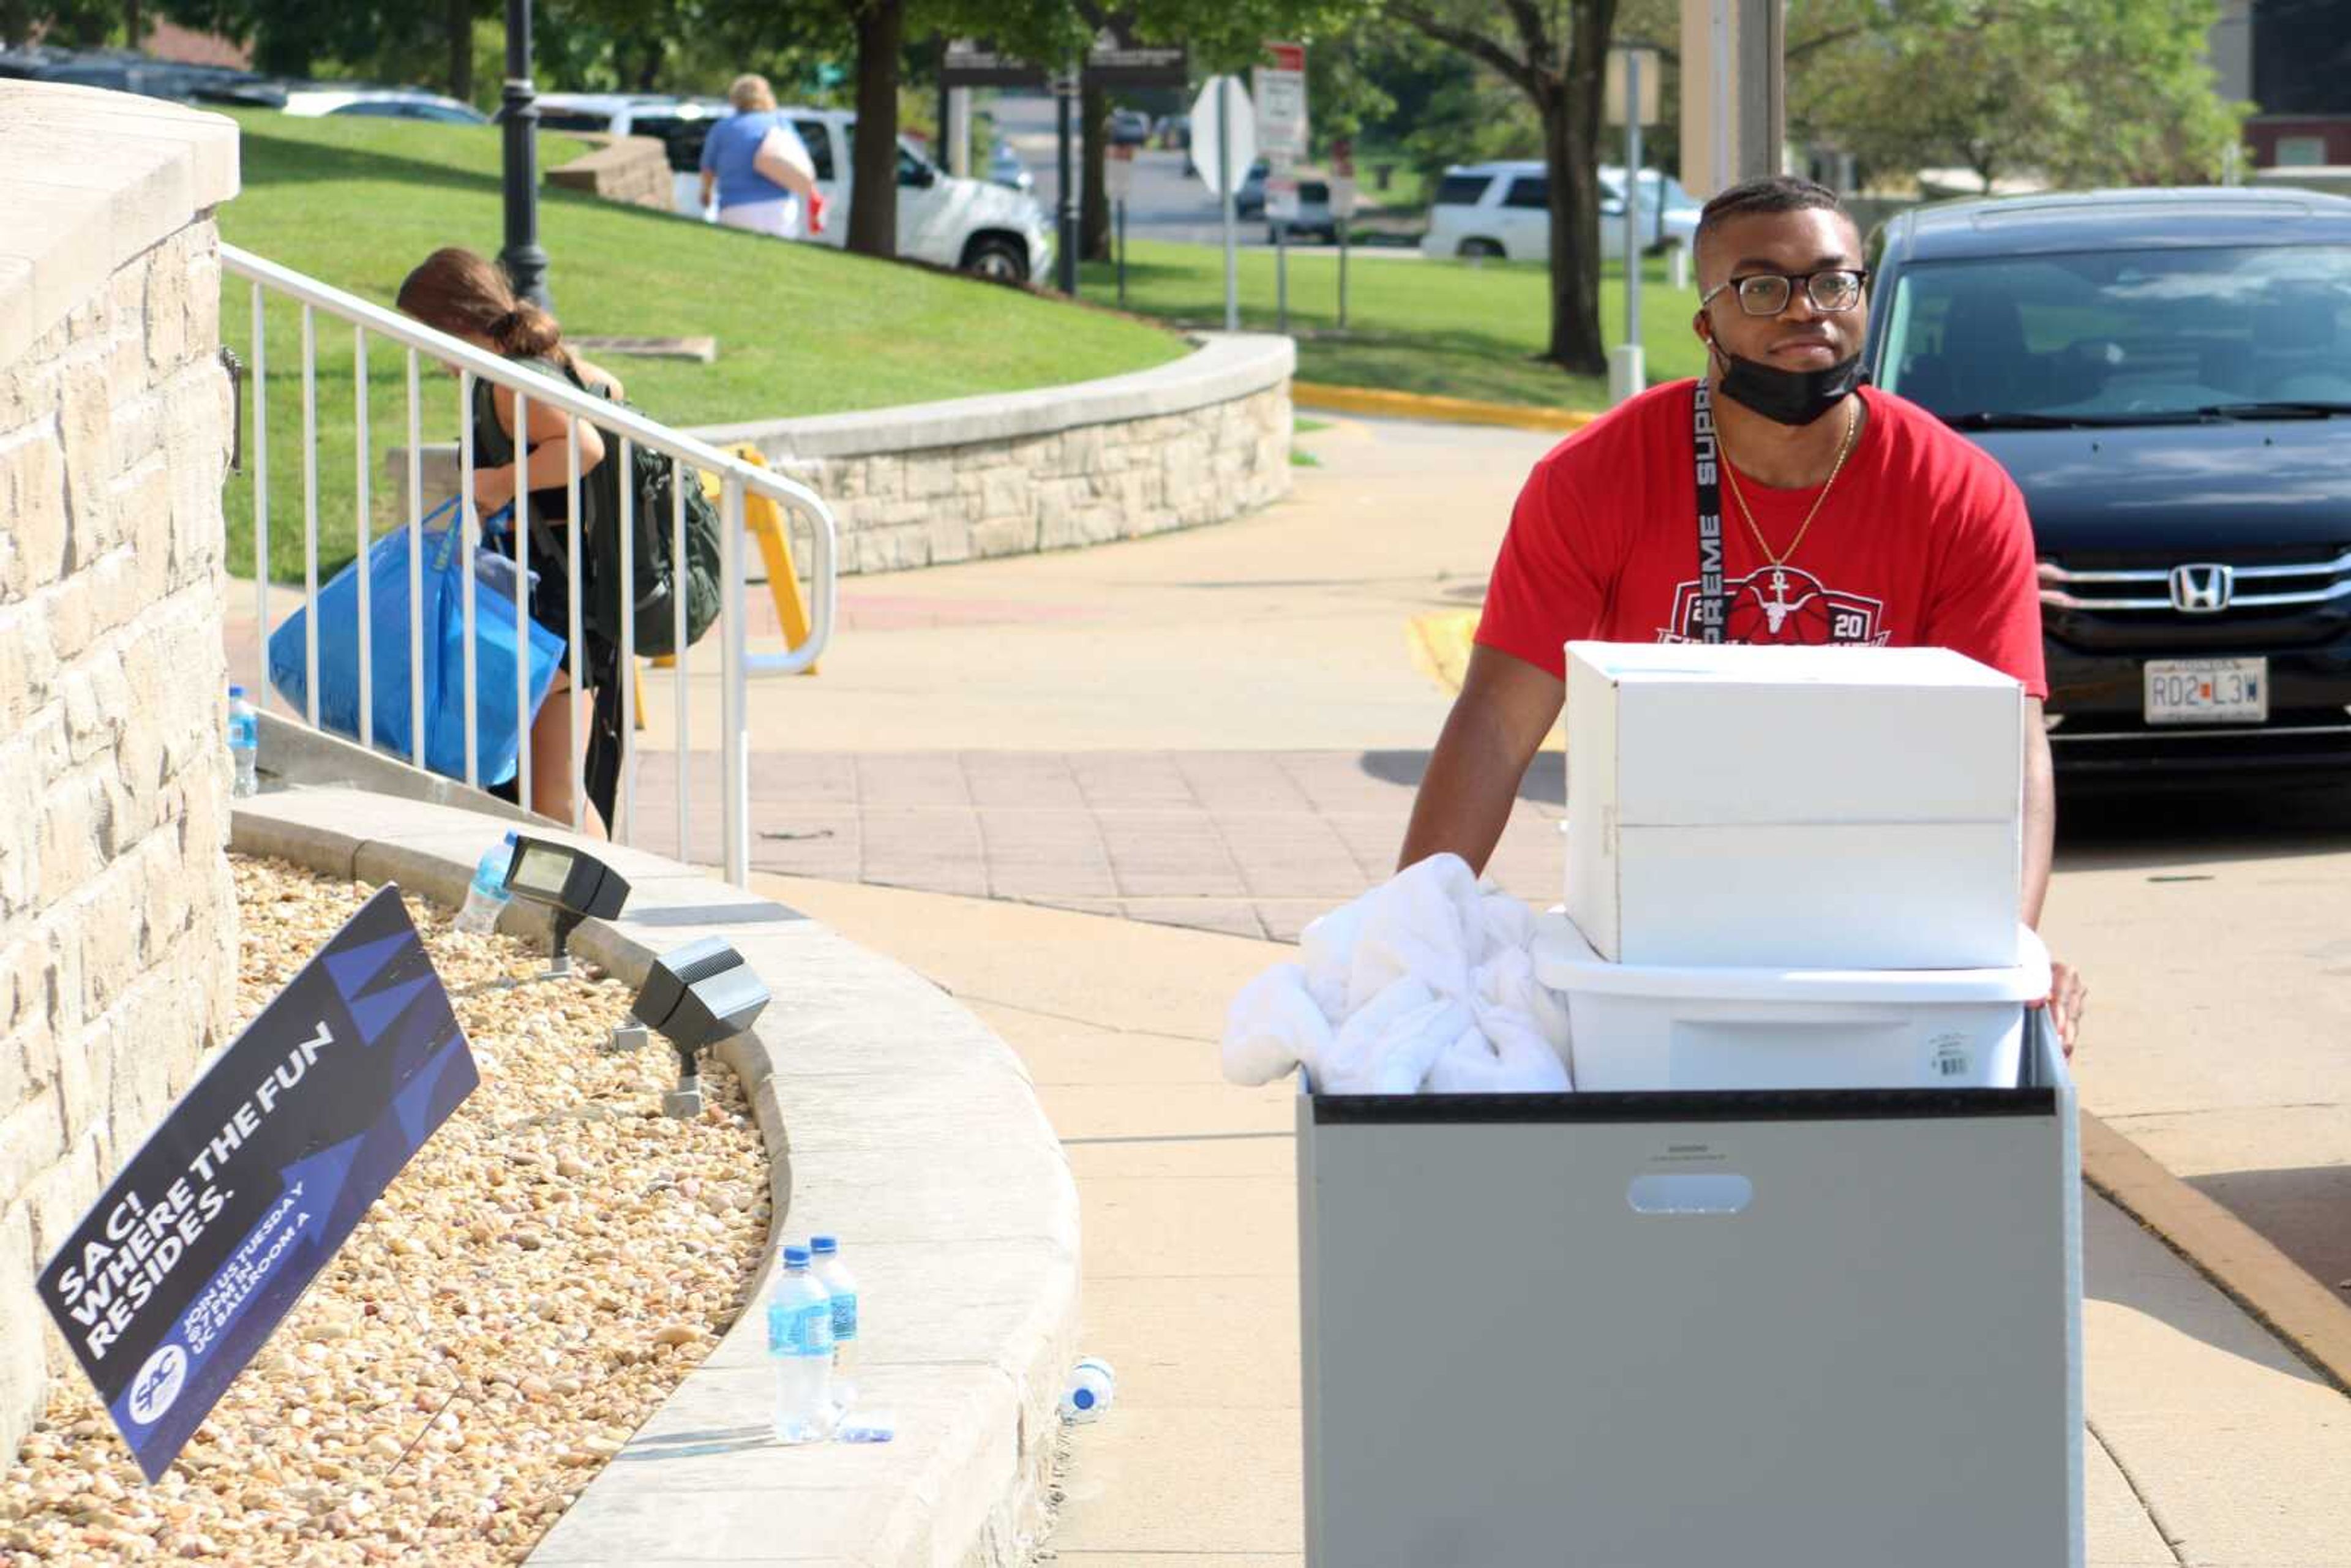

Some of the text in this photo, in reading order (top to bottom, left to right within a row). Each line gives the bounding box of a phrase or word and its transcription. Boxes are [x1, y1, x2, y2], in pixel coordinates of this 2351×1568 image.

[1833, 613, 1863, 638] 20
[70, 1020, 334, 1327] WHERE THE FUN
[58, 1190, 145, 1306] SAC!
[86, 1184, 234, 1360] RESIDES.
[184, 1180, 304, 1334] JOIN US TUESDAY
[192, 1212, 310, 1355] UC BALLROOM A
[235, 1261, 254, 1285] IN
